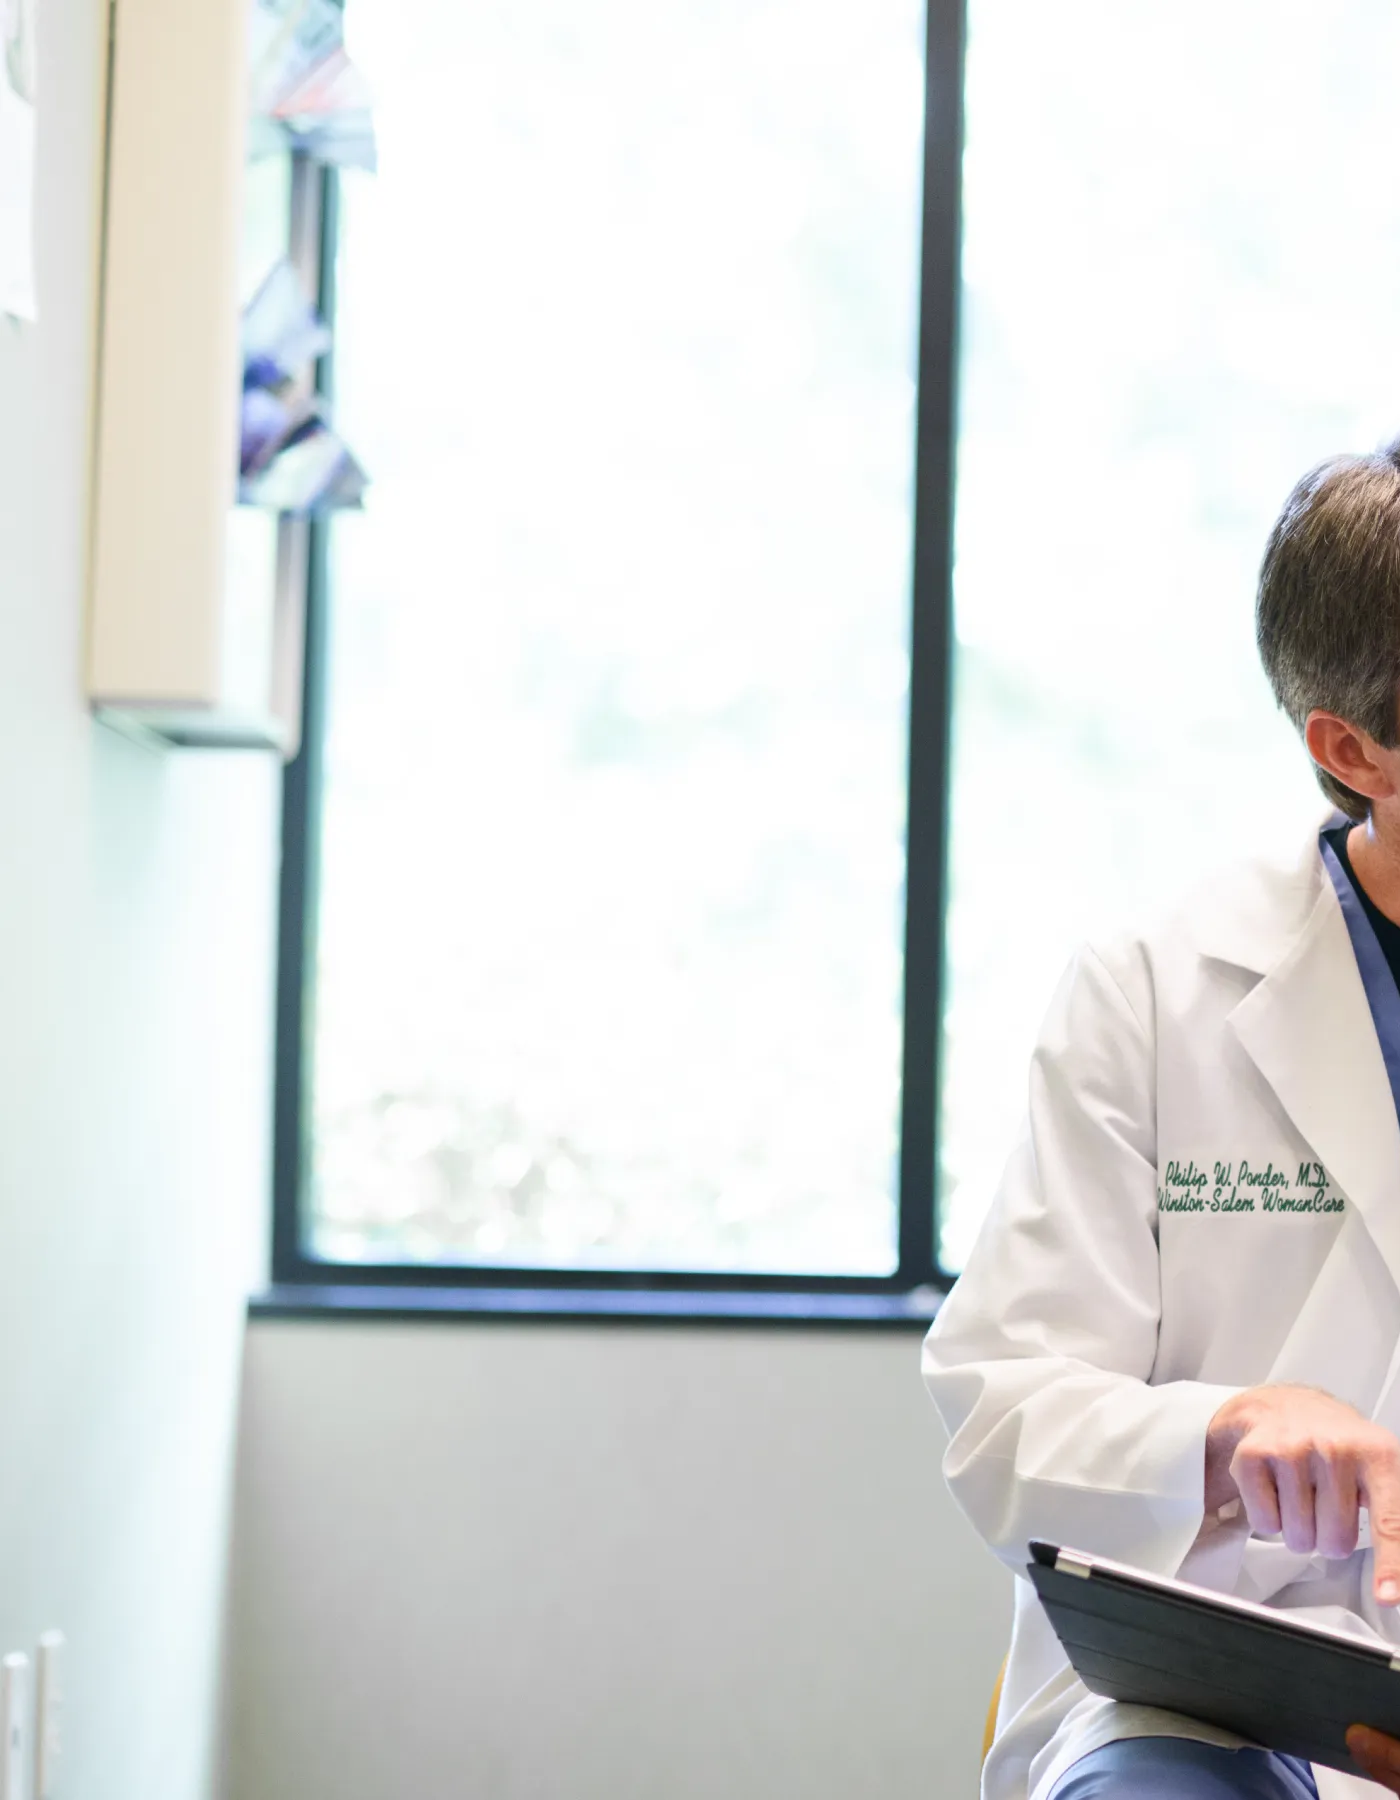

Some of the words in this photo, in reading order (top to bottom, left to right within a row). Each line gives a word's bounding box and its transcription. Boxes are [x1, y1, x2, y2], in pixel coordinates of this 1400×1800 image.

[1165, 1161, 1208, 1195] Philip
[1214, 1161, 1232, 1186] W.
[1296, 1162, 1330, 1188] M.D.
[1157, 1187, 1255, 1212] Winston-Salem
[1261, 1187, 1345, 1213] WomanCare
